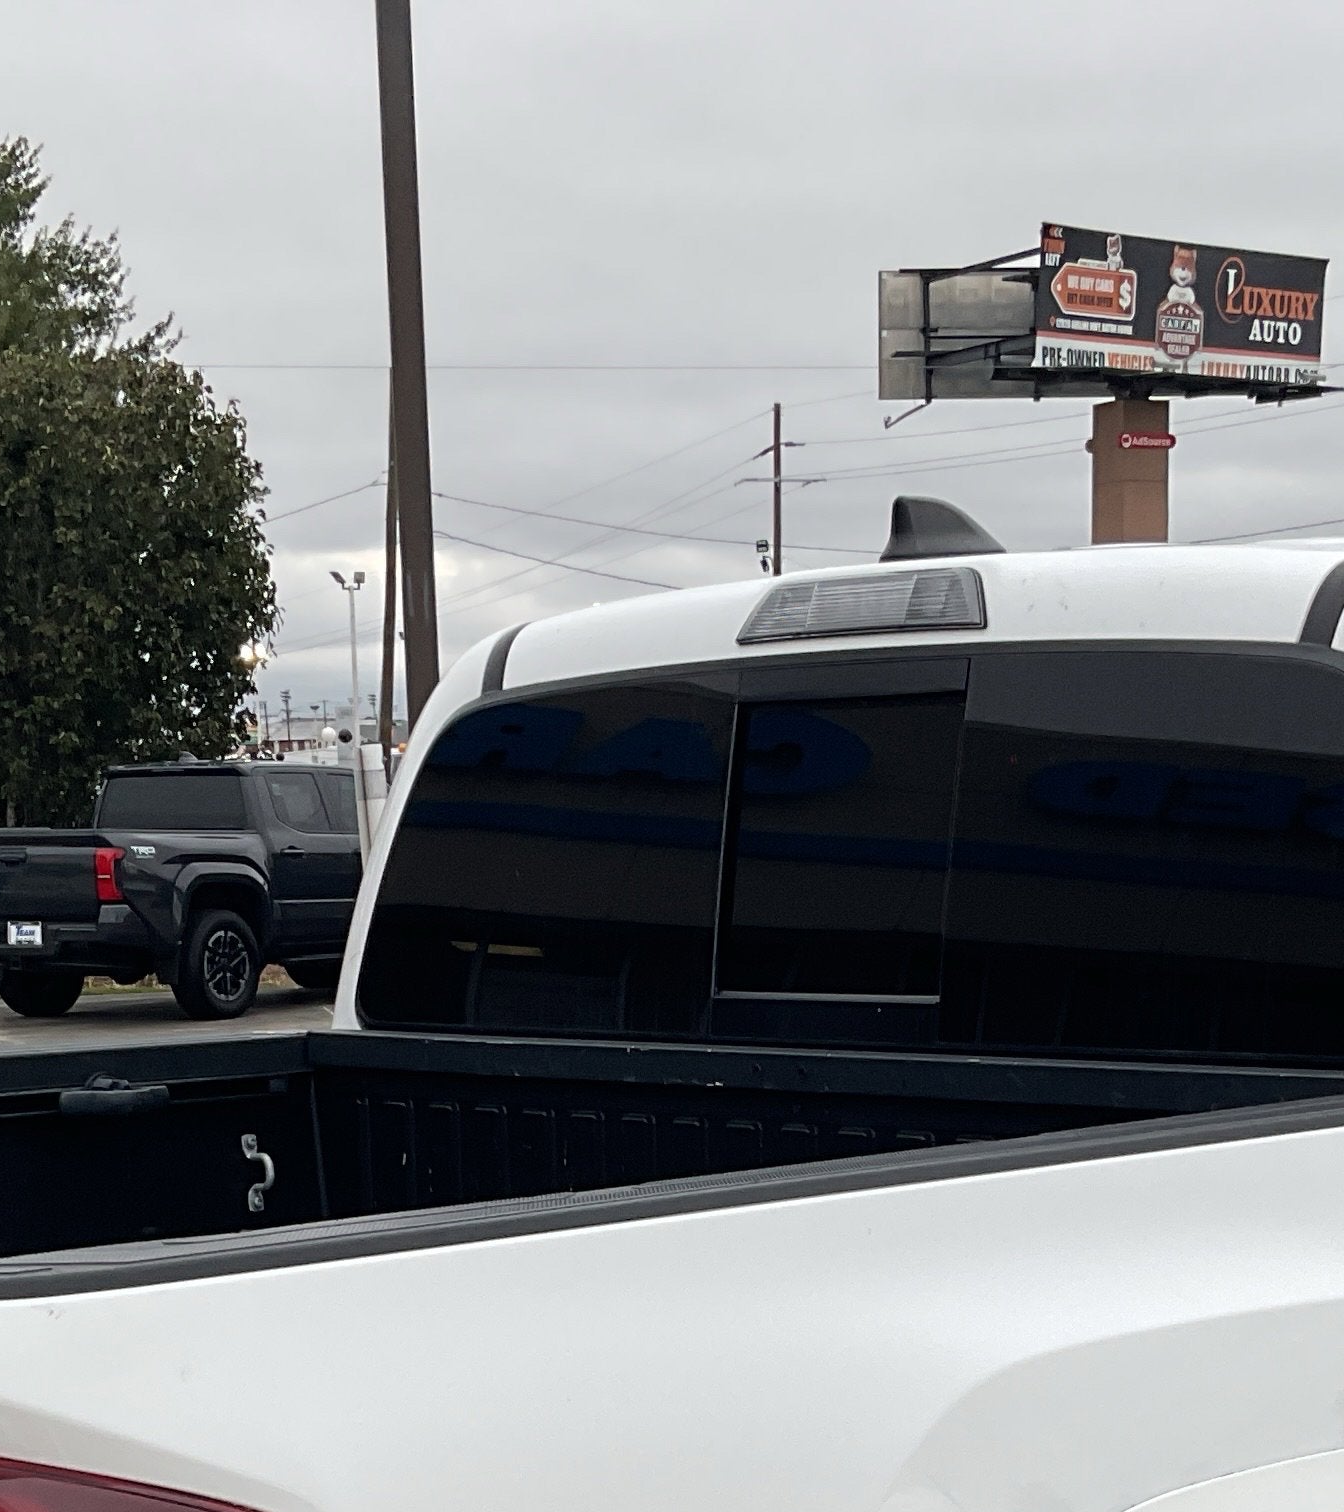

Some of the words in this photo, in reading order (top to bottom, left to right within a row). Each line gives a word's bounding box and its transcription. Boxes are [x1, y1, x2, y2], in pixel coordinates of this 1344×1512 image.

[1225, 268, 1319, 321] LUXURY
[1248, 318, 1302, 346] AUTO
[1042, 345, 1105, 368] PRE-OWNED
[1107, 351, 1156, 372] VEHICLES
